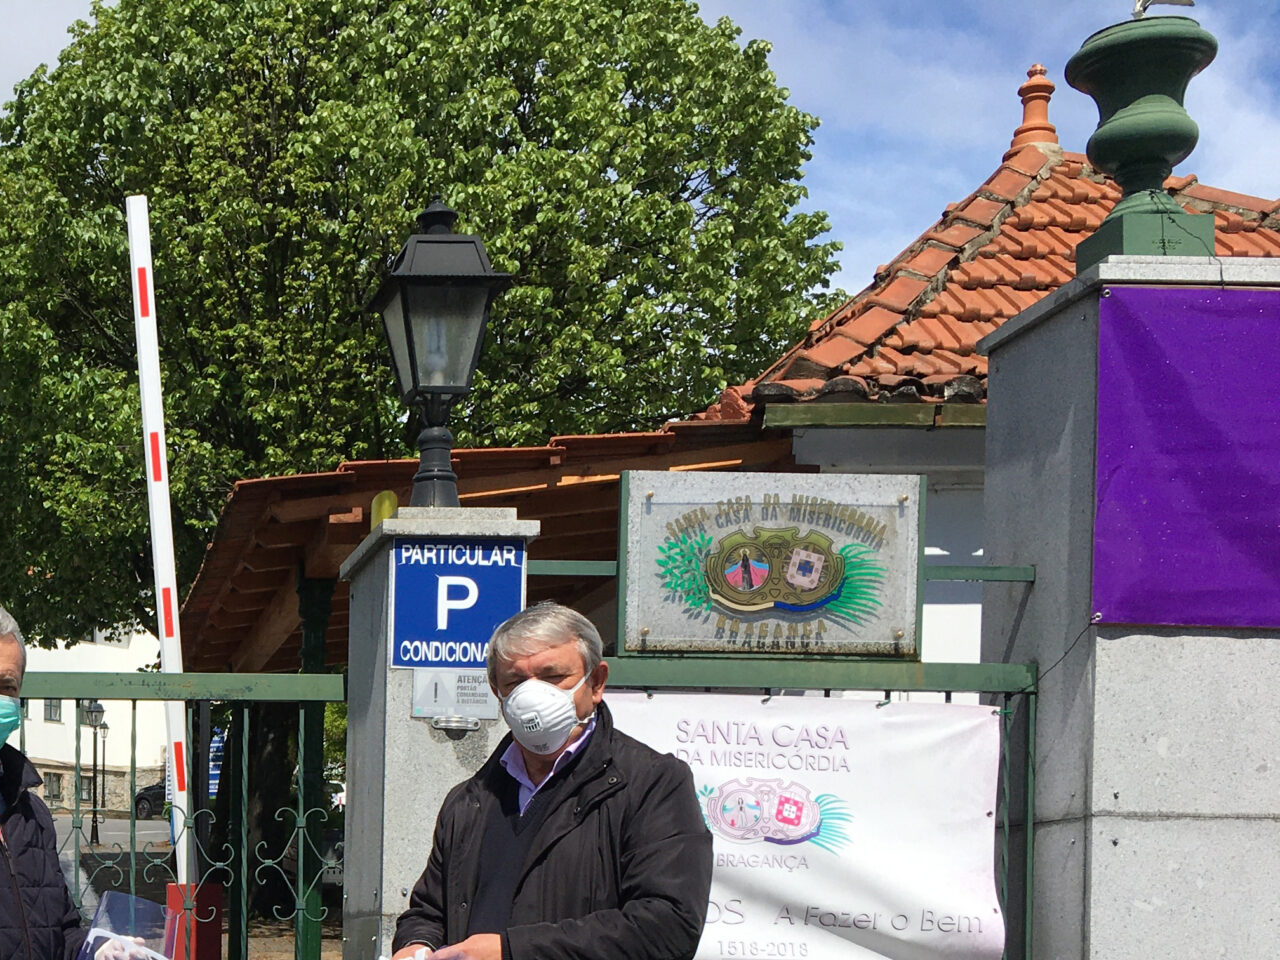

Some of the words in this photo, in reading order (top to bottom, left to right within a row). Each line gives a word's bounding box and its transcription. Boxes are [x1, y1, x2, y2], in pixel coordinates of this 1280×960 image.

[716, 494, 752, 516] CASA
[763, 493, 780, 508] DA
[400, 544, 517, 566] PARTICULAR
[436, 575, 479, 630] P
[400, 640, 489, 662] CONDICIONA
[457, 674, 487, 686] ATENÇÃ
[676, 718, 764, 746] SANTA
[771, 723, 850, 750] CASA
[710, 748, 851, 773] MISERICÓRDIA
[716, 853, 809, 873] BRAGANÇA
[705, 899, 745, 925] OS
[773, 903, 795, 925] A
[803, 904, 882, 930] Fazer
[891, 914, 909, 931] o
[920, 908, 983, 934] Bem
[717, 940, 809, 957] 1518-2018
